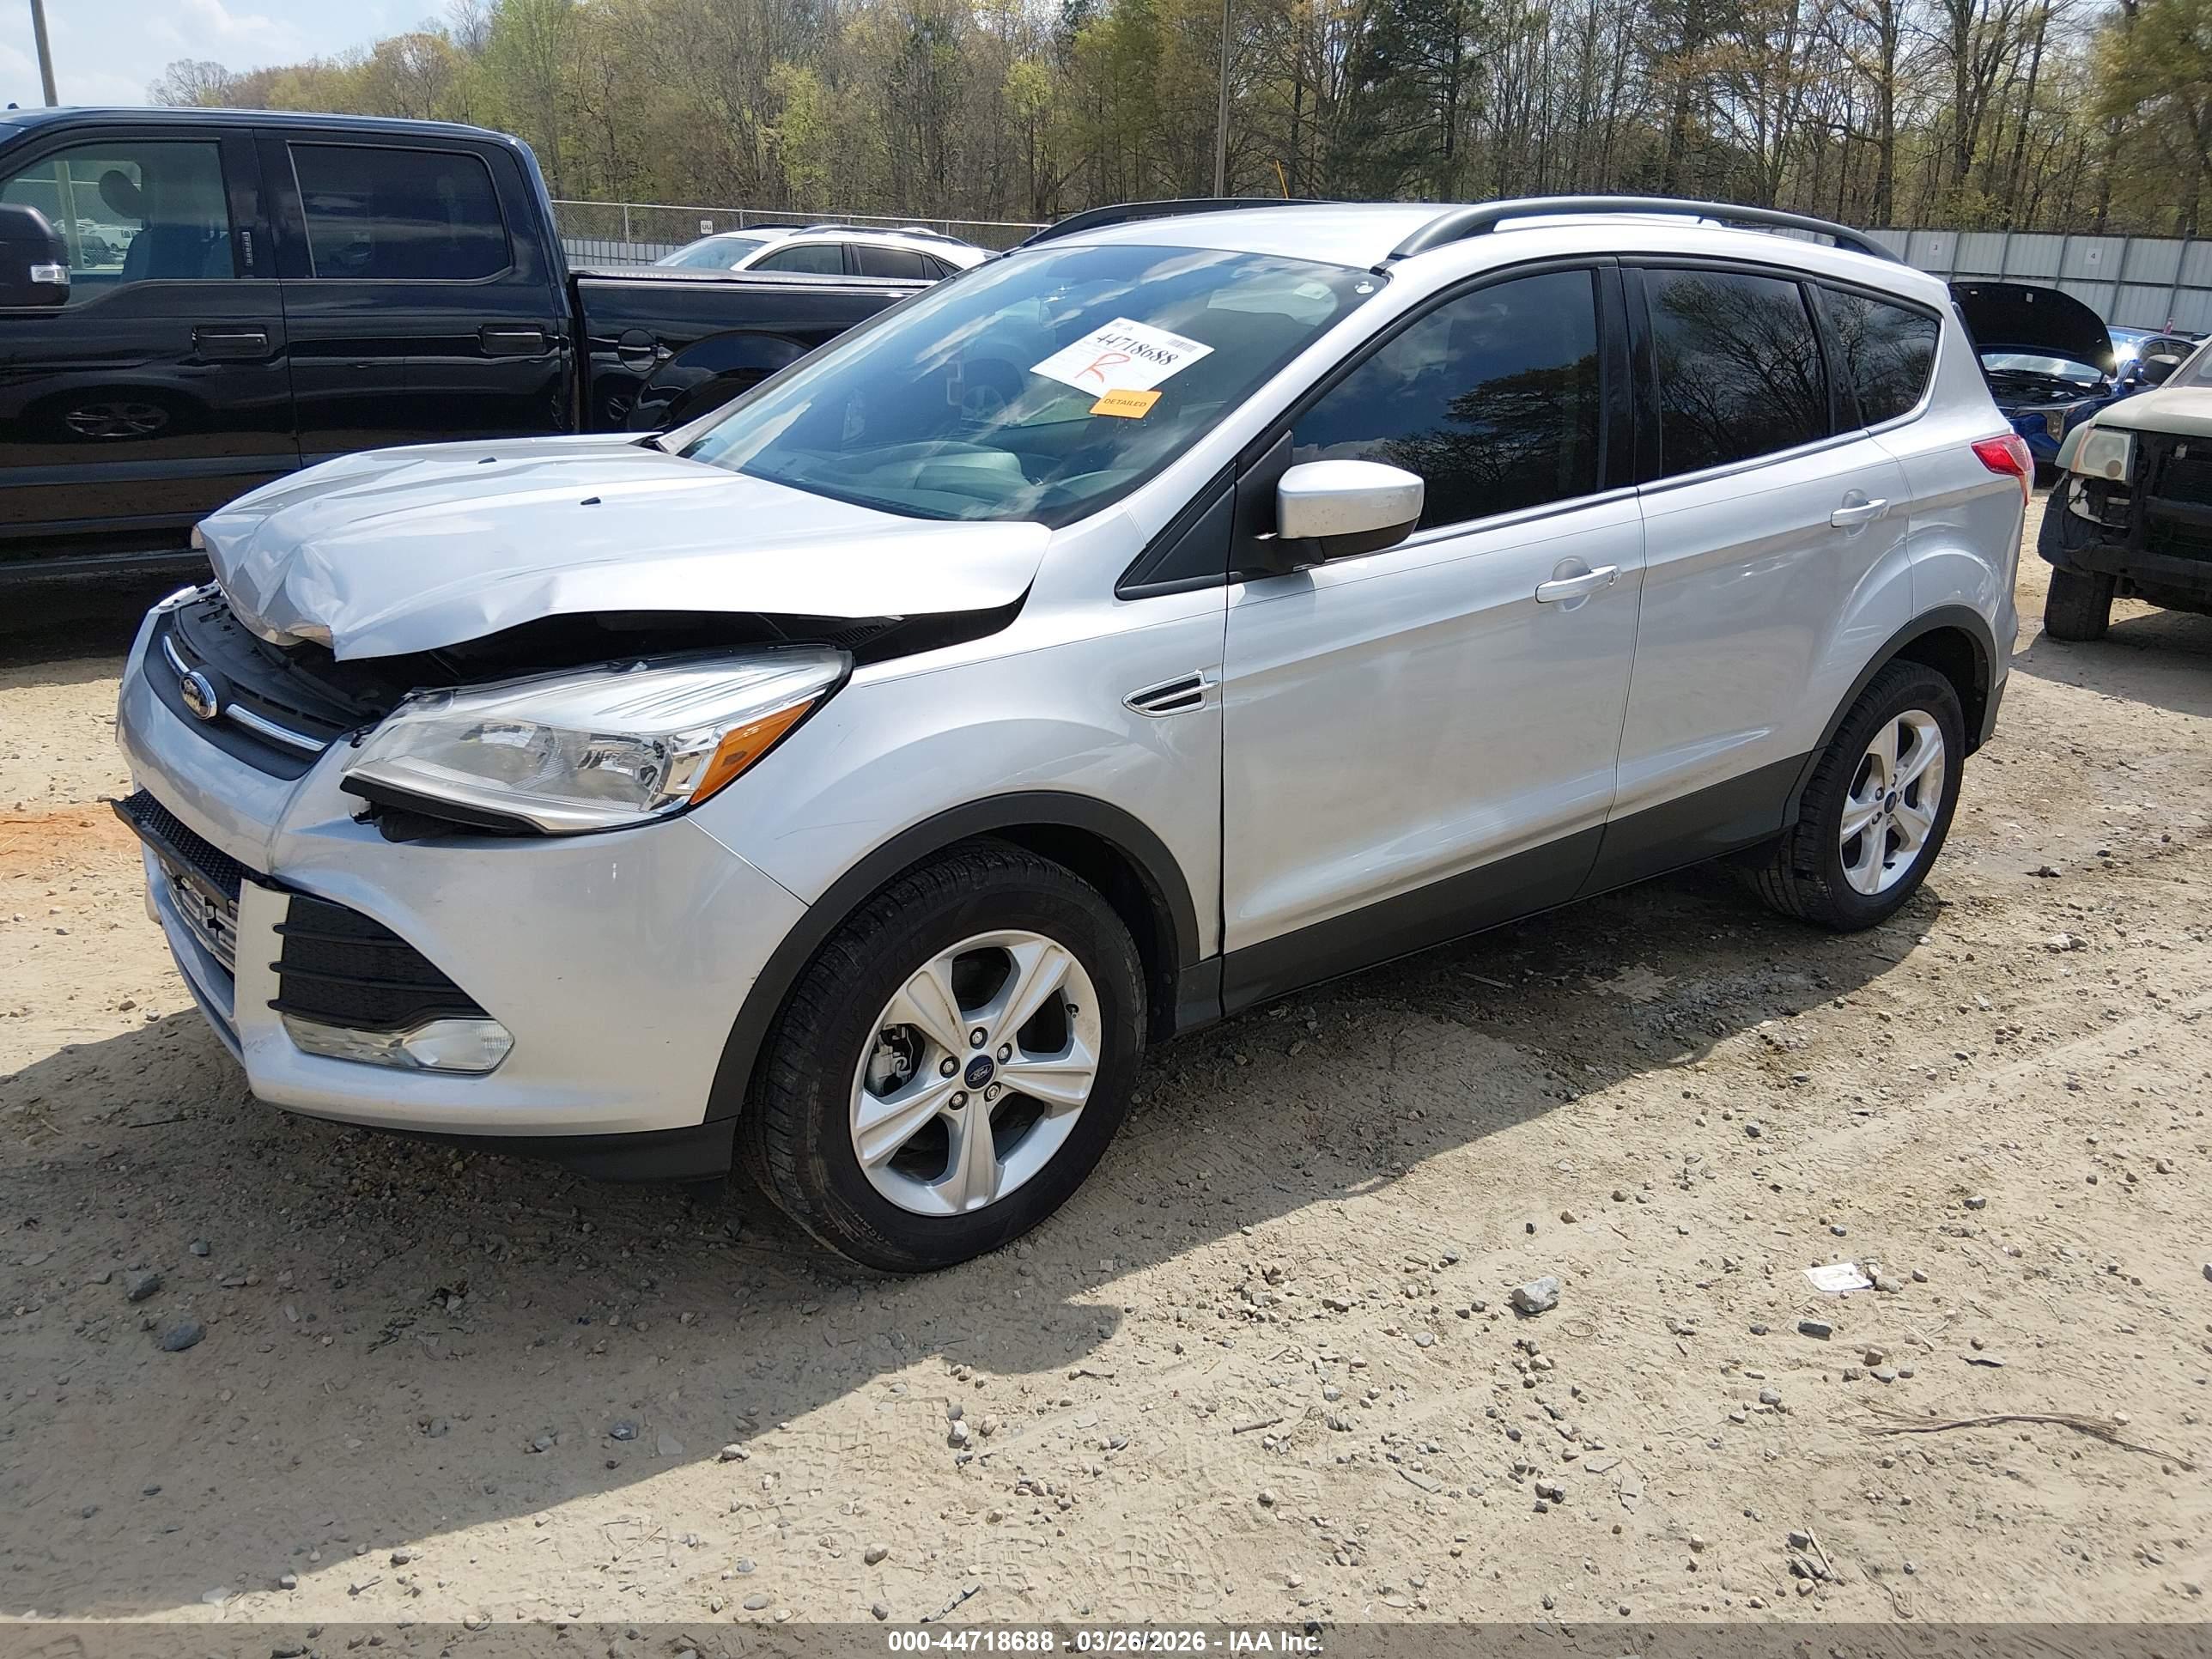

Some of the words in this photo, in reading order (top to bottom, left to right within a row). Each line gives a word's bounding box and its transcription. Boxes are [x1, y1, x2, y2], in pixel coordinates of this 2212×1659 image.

[1096, 333, 1179, 366] 44718688
[1103, 398, 1147, 408] DETAILED
[972, 1066, 989, 1081] Ford
